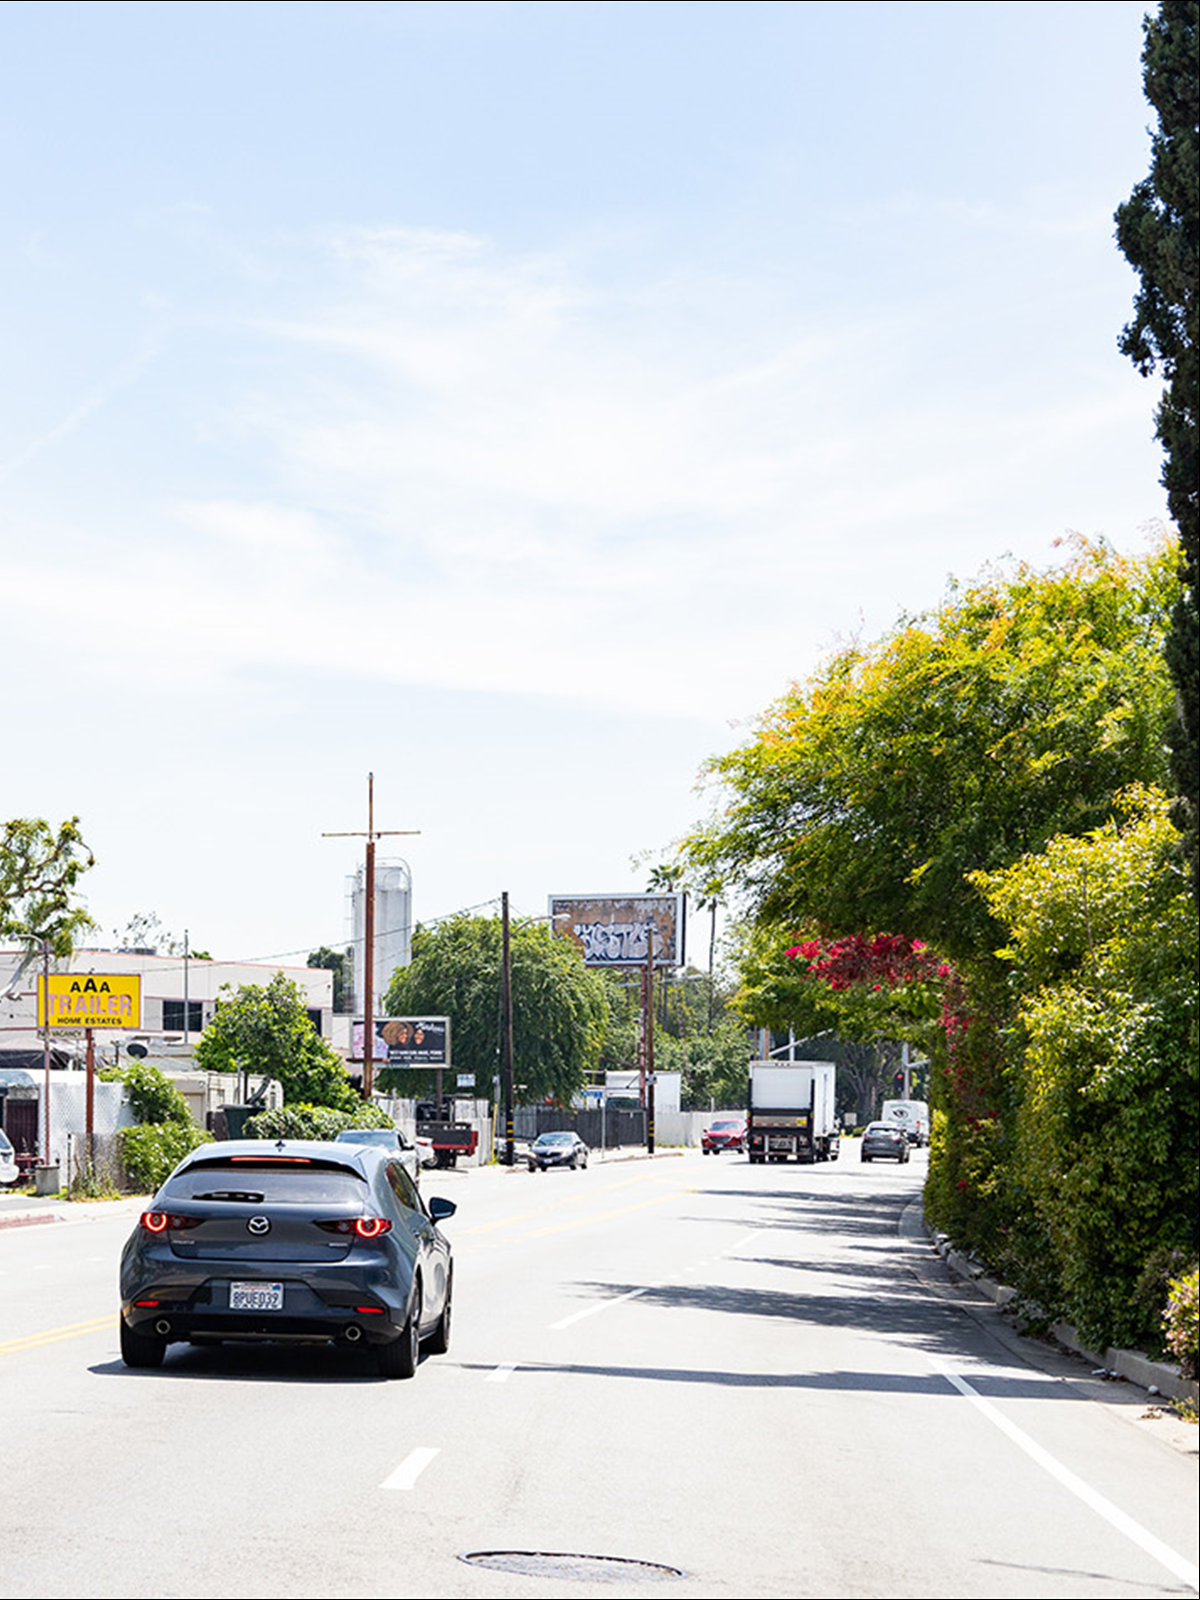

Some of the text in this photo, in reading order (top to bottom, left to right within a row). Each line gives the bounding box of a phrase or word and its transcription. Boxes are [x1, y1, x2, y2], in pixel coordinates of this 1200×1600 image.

[70, 978, 111, 993] AAA
[48, 994, 132, 1016] TRAILER
[85, 1017, 122, 1025] ESTATES
